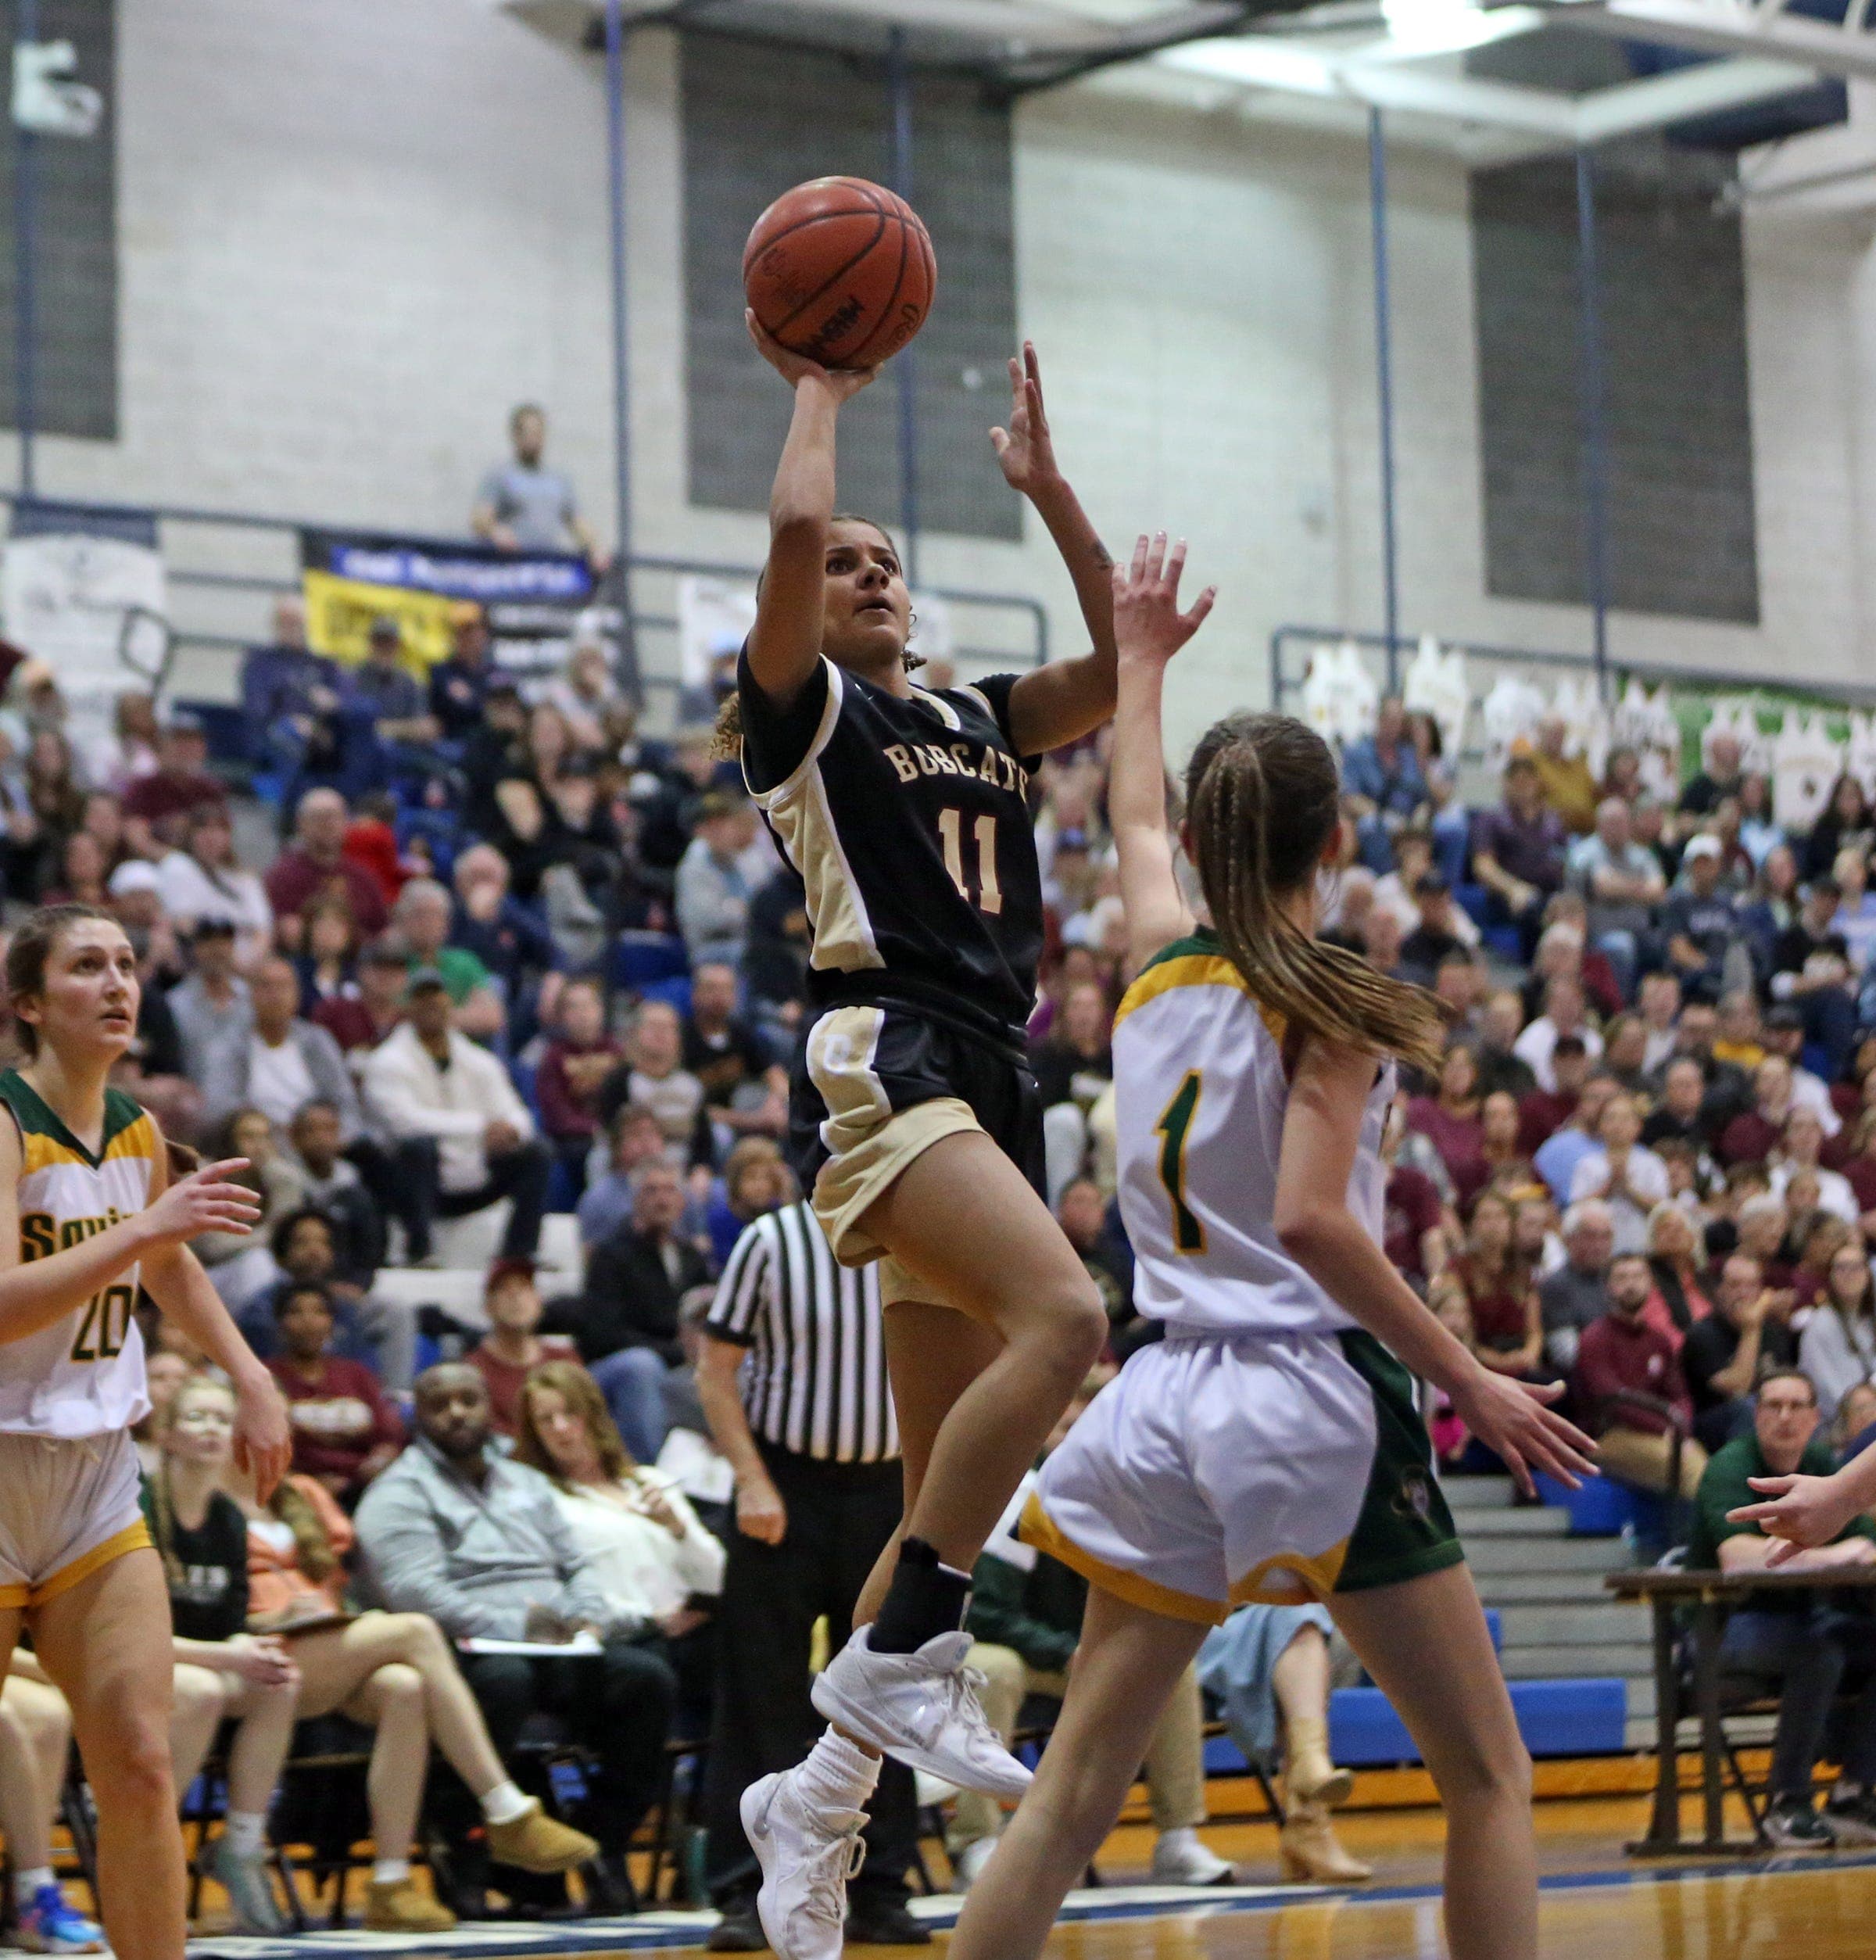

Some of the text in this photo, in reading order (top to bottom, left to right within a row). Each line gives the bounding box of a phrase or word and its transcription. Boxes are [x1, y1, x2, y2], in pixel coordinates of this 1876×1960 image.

[938, 807, 1002, 914] 11
[1151, 1067, 1208, 1256] 1
[71, 1285, 133, 1363] 20
